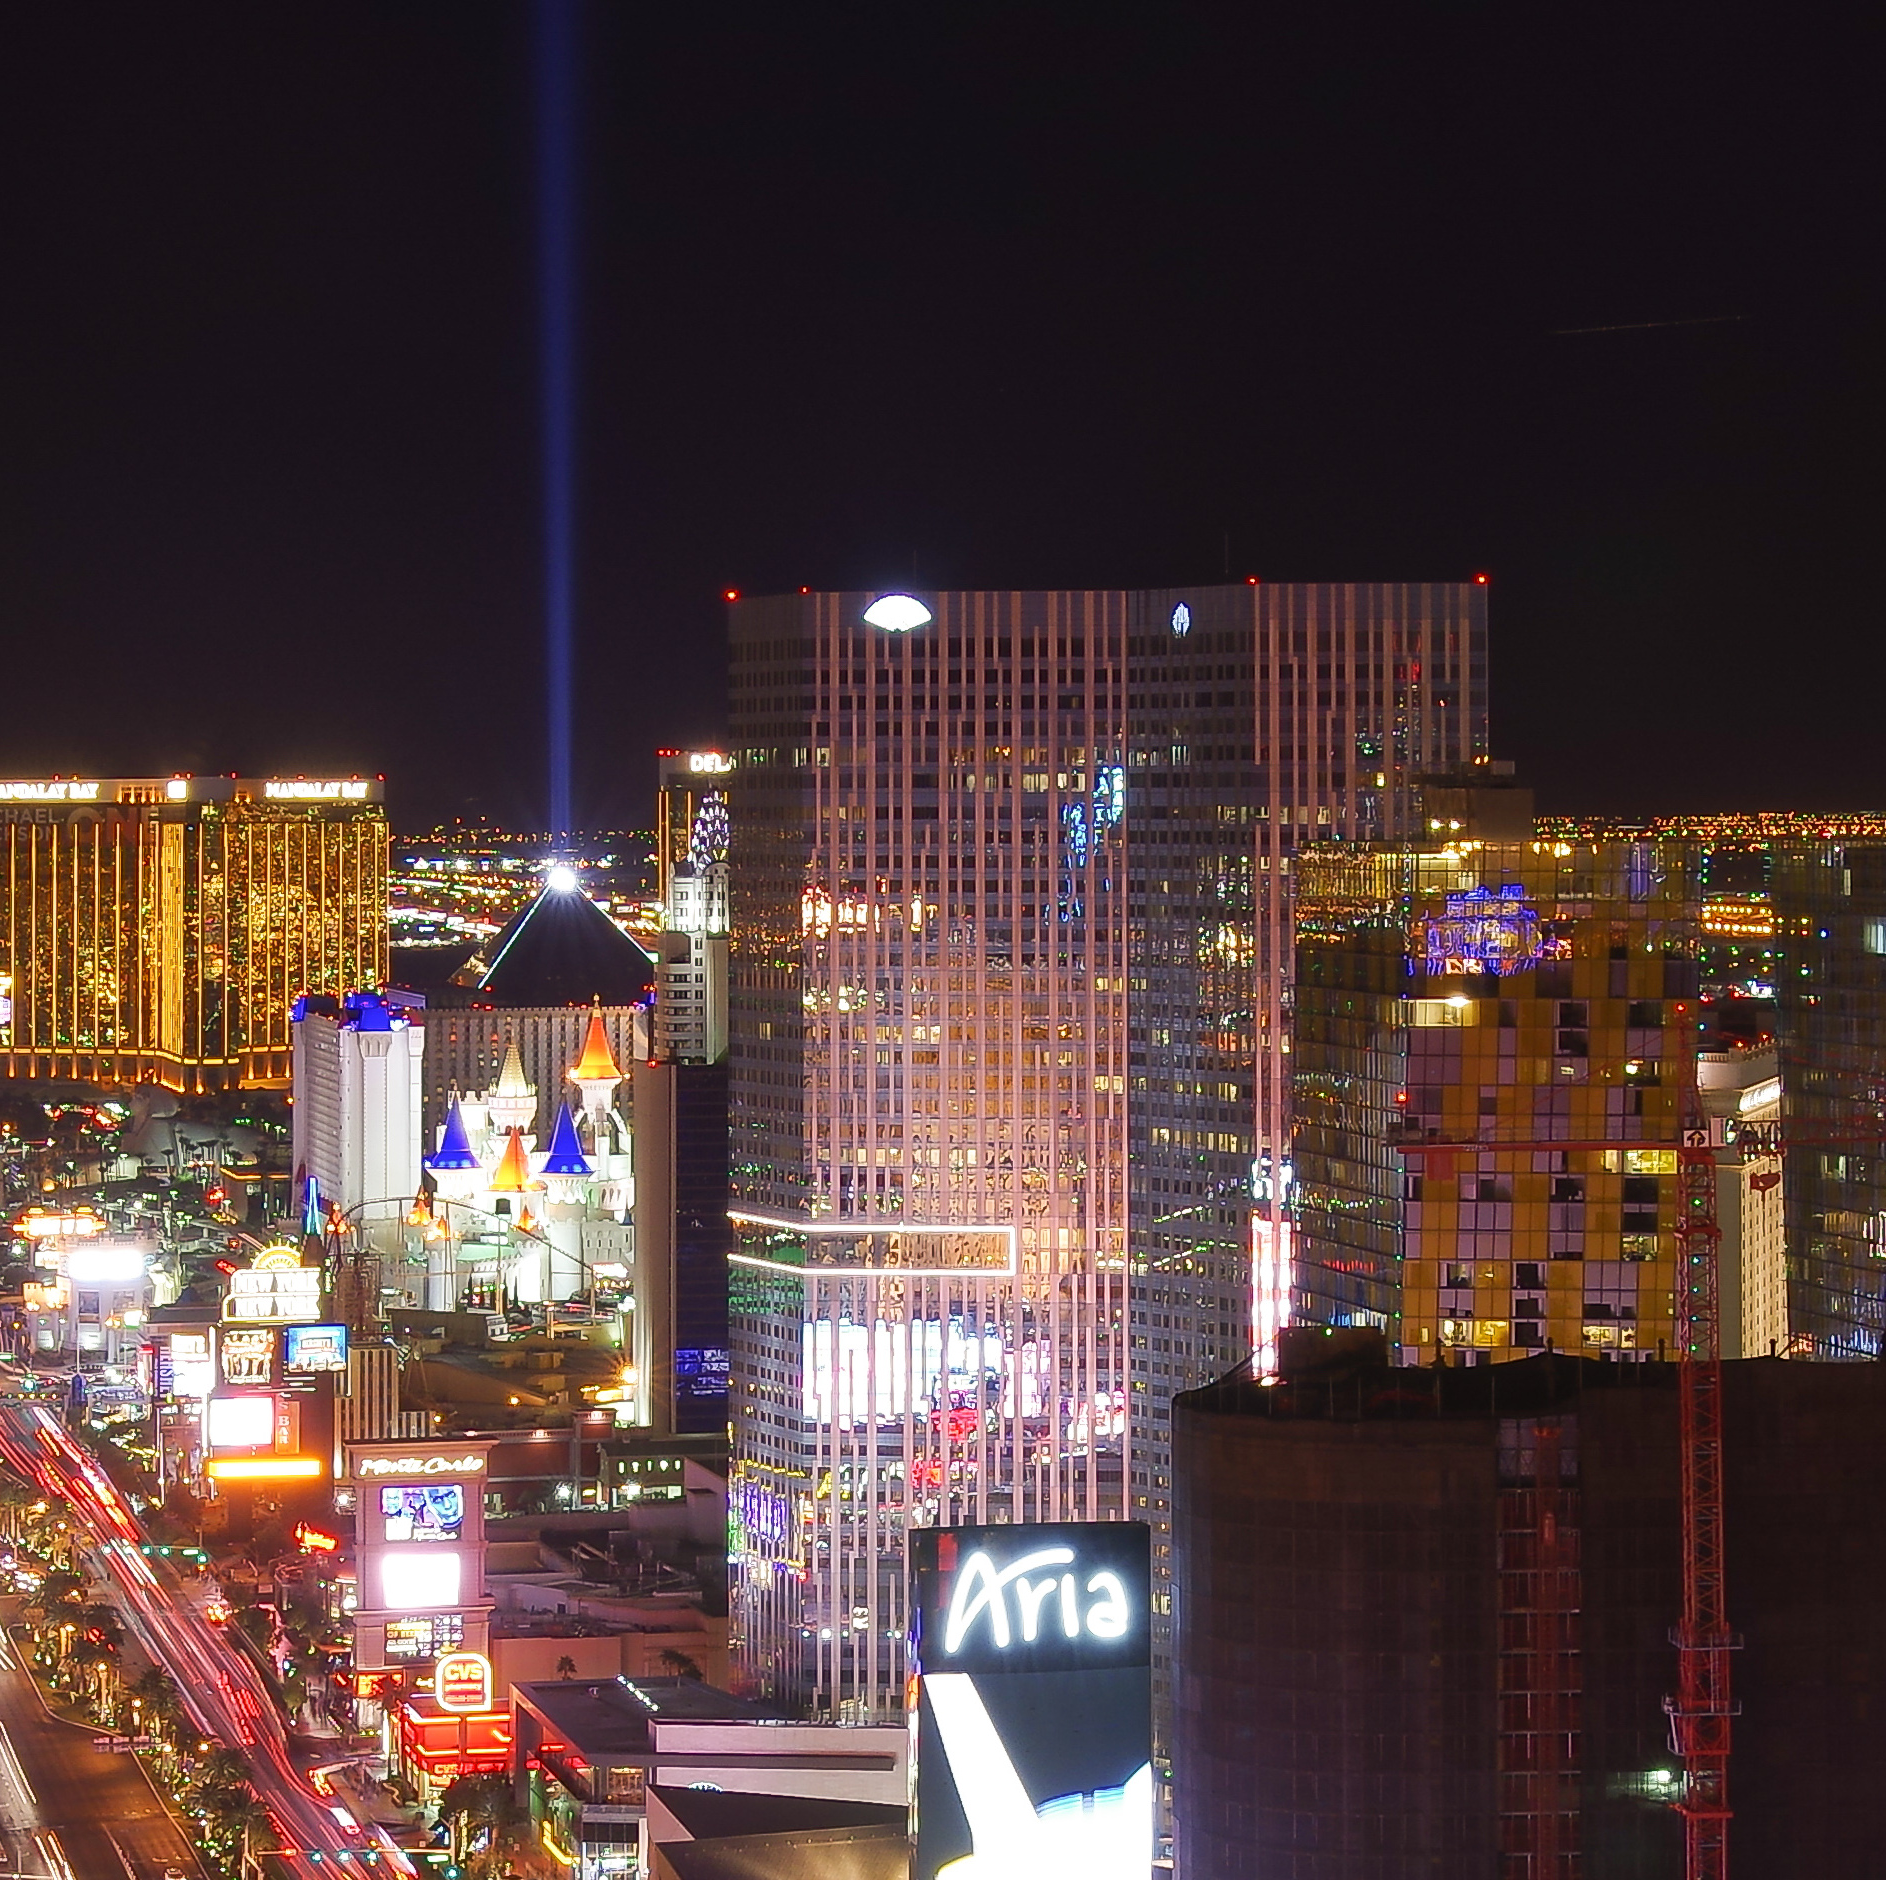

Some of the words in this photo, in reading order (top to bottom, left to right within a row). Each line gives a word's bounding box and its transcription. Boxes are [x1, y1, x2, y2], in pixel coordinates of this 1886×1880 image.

[69, 783, 100, 799] BAY
[265, 781, 340, 799] MANDALAY
[342, 781, 368, 798] BAY
[359, 1458, 424, 1476] Monte
[422, 1455, 484, 1475] Carlo
[945, 1547, 1129, 1654] Aria
[444, 1663, 484, 1680] CVS
